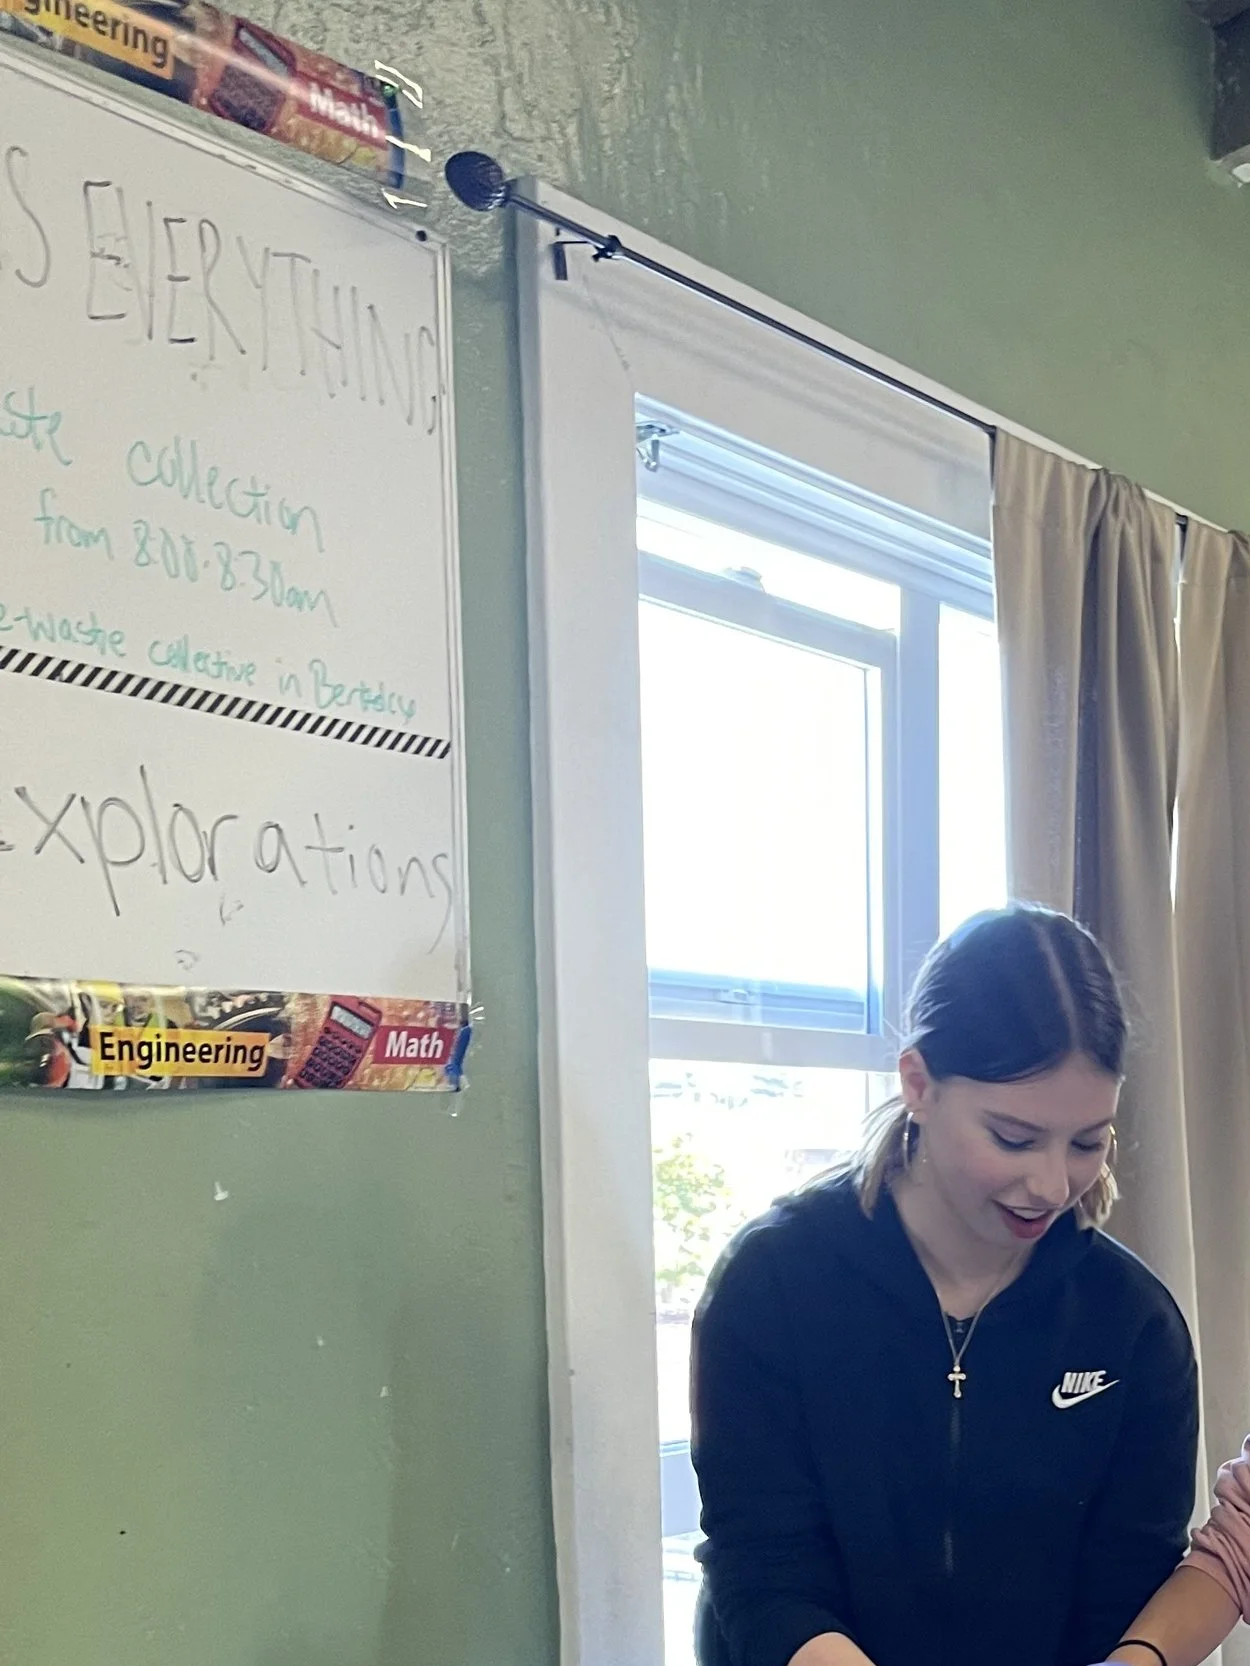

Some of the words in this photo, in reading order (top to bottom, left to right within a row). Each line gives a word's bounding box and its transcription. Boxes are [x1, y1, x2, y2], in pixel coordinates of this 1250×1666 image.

[25, 0, 168, 68] neering
[309, 82, 380, 138] Math
[0, 387, 73, 466] ste
[127, 434, 325, 553] collection
[34, 488, 114, 560] from
[0, 764, 453, 953] xplorations
[100, 1031, 266, 1072] Engineering
[385, 1031, 445, 1059] Math
[1060, 1369, 1107, 1394] NIKE
